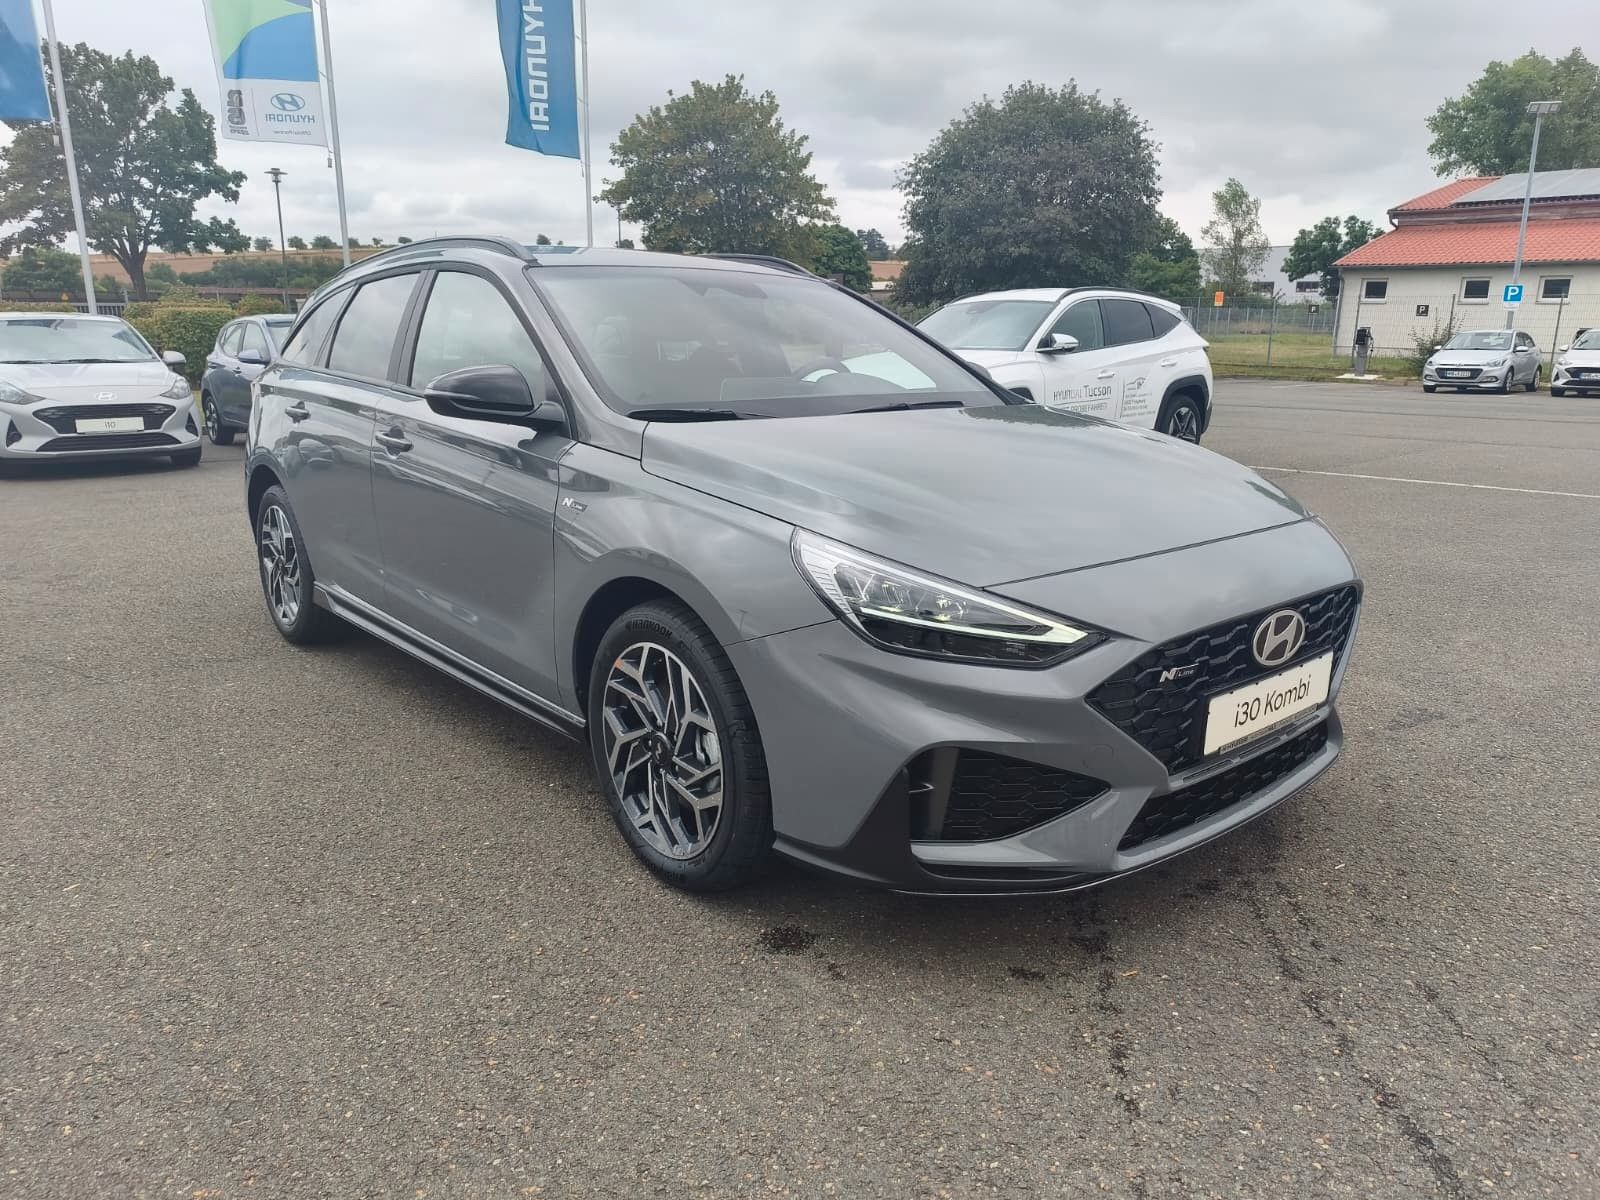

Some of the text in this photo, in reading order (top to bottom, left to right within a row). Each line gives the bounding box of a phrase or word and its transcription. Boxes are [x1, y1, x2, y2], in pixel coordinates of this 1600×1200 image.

[1507, 286, 1520, 300] P
[1083, 384, 1112, 397] Tucson
[1159, 668, 1177, 682] N
[1234, 696, 1261, 728] i30
[1264, 673, 1312, 716] Kombi
